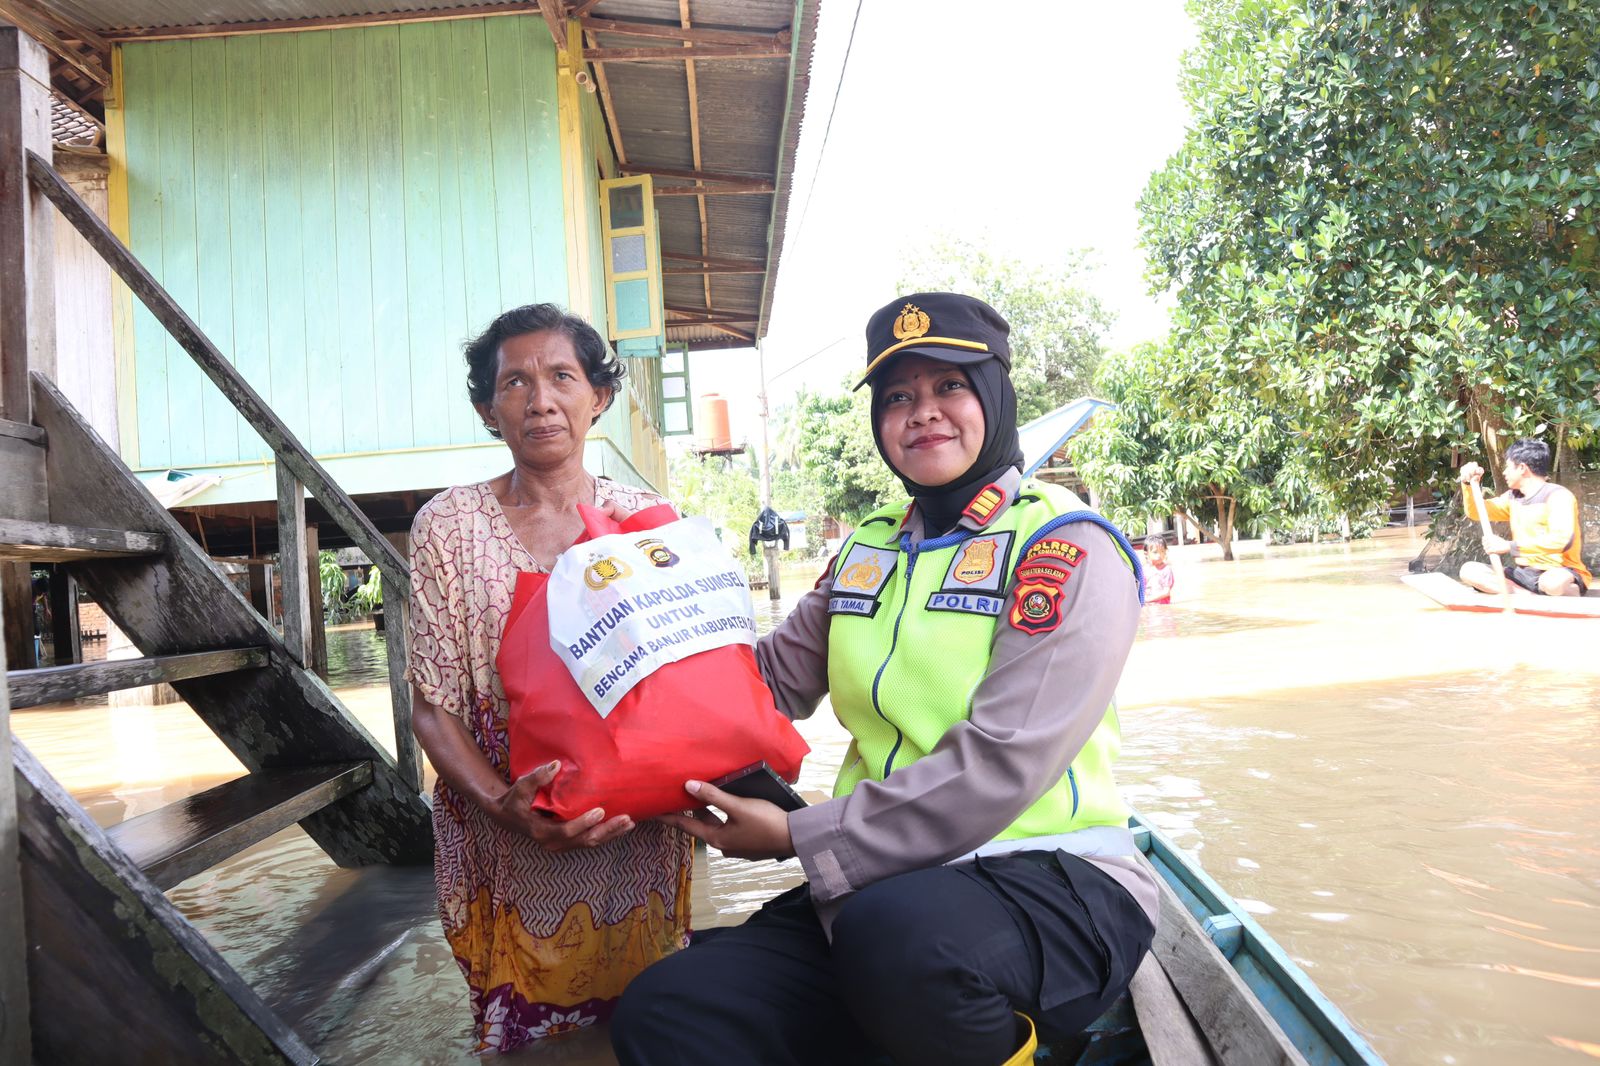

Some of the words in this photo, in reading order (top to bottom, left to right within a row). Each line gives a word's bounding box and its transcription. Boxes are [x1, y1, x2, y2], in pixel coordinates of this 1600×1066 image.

[570, 598, 634, 660] BANTUAN
[632, 582, 700, 610] KAPOLDA
[694, 571, 744, 593] SUMSEL
[646, 603, 705, 630] UNTUK
[932, 594, 998, 612] POLRI
[593, 645, 649, 698] BENCANA
[648, 628, 694, 654] BANJIR
[691, 616, 748, 638] KABUPATEN
